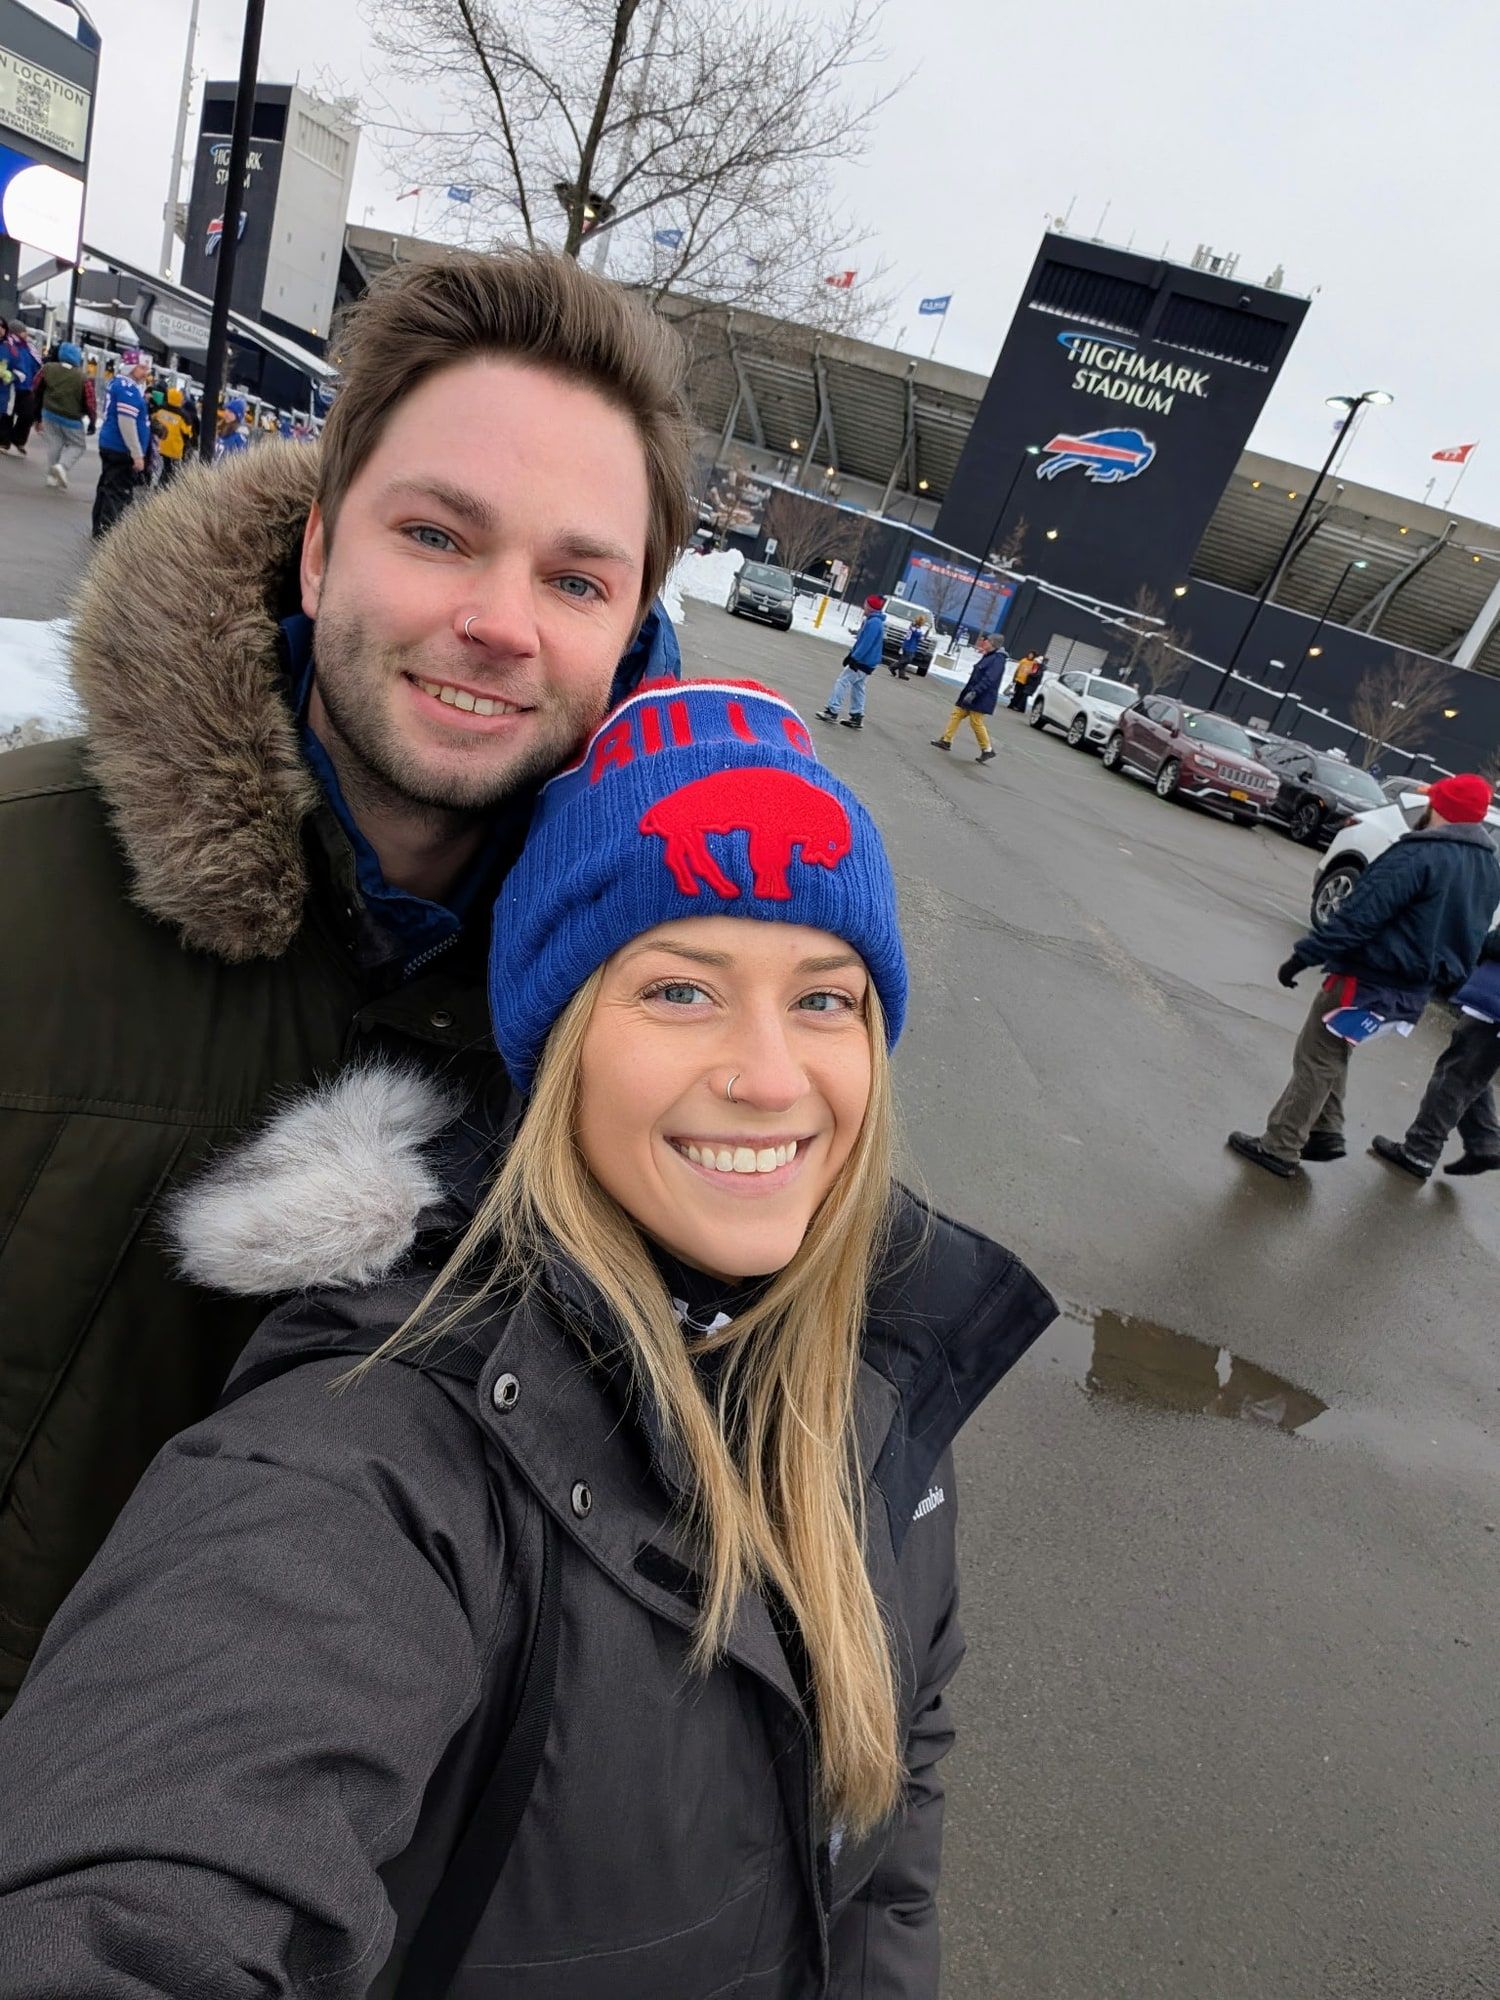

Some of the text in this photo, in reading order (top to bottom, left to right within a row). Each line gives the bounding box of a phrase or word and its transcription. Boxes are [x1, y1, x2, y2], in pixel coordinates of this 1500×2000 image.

[0, 54, 85, 107] N LOCATION
[26, 127, 69, 151] EXPERIENCES
[41, 126, 75, 148] EXCLUSIVE
[172, 320, 209, 338] LOCATION
[1071, 368, 1175, 416] STADIUM
